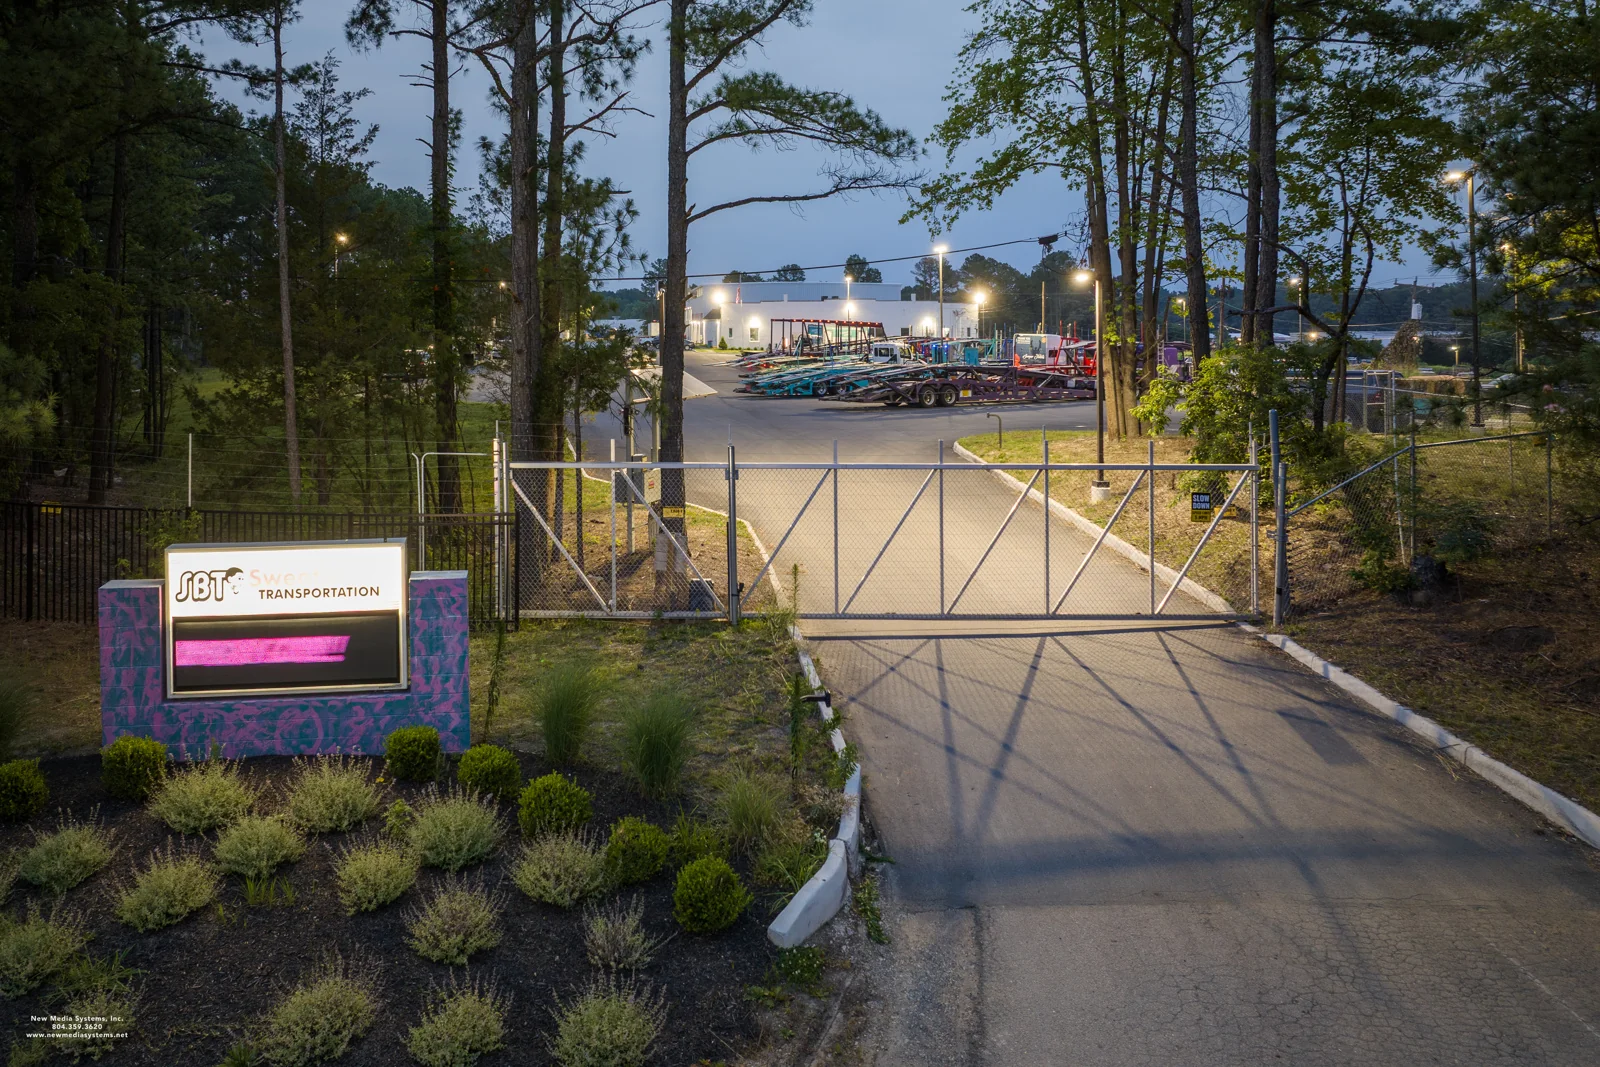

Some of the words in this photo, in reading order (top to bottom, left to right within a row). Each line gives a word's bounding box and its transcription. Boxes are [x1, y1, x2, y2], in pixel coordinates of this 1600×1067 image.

[1193, 494, 1209, 502] SLOW
[175, 570, 228, 602] SBT
[258, 586, 381, 600] TRANSPORTATION
